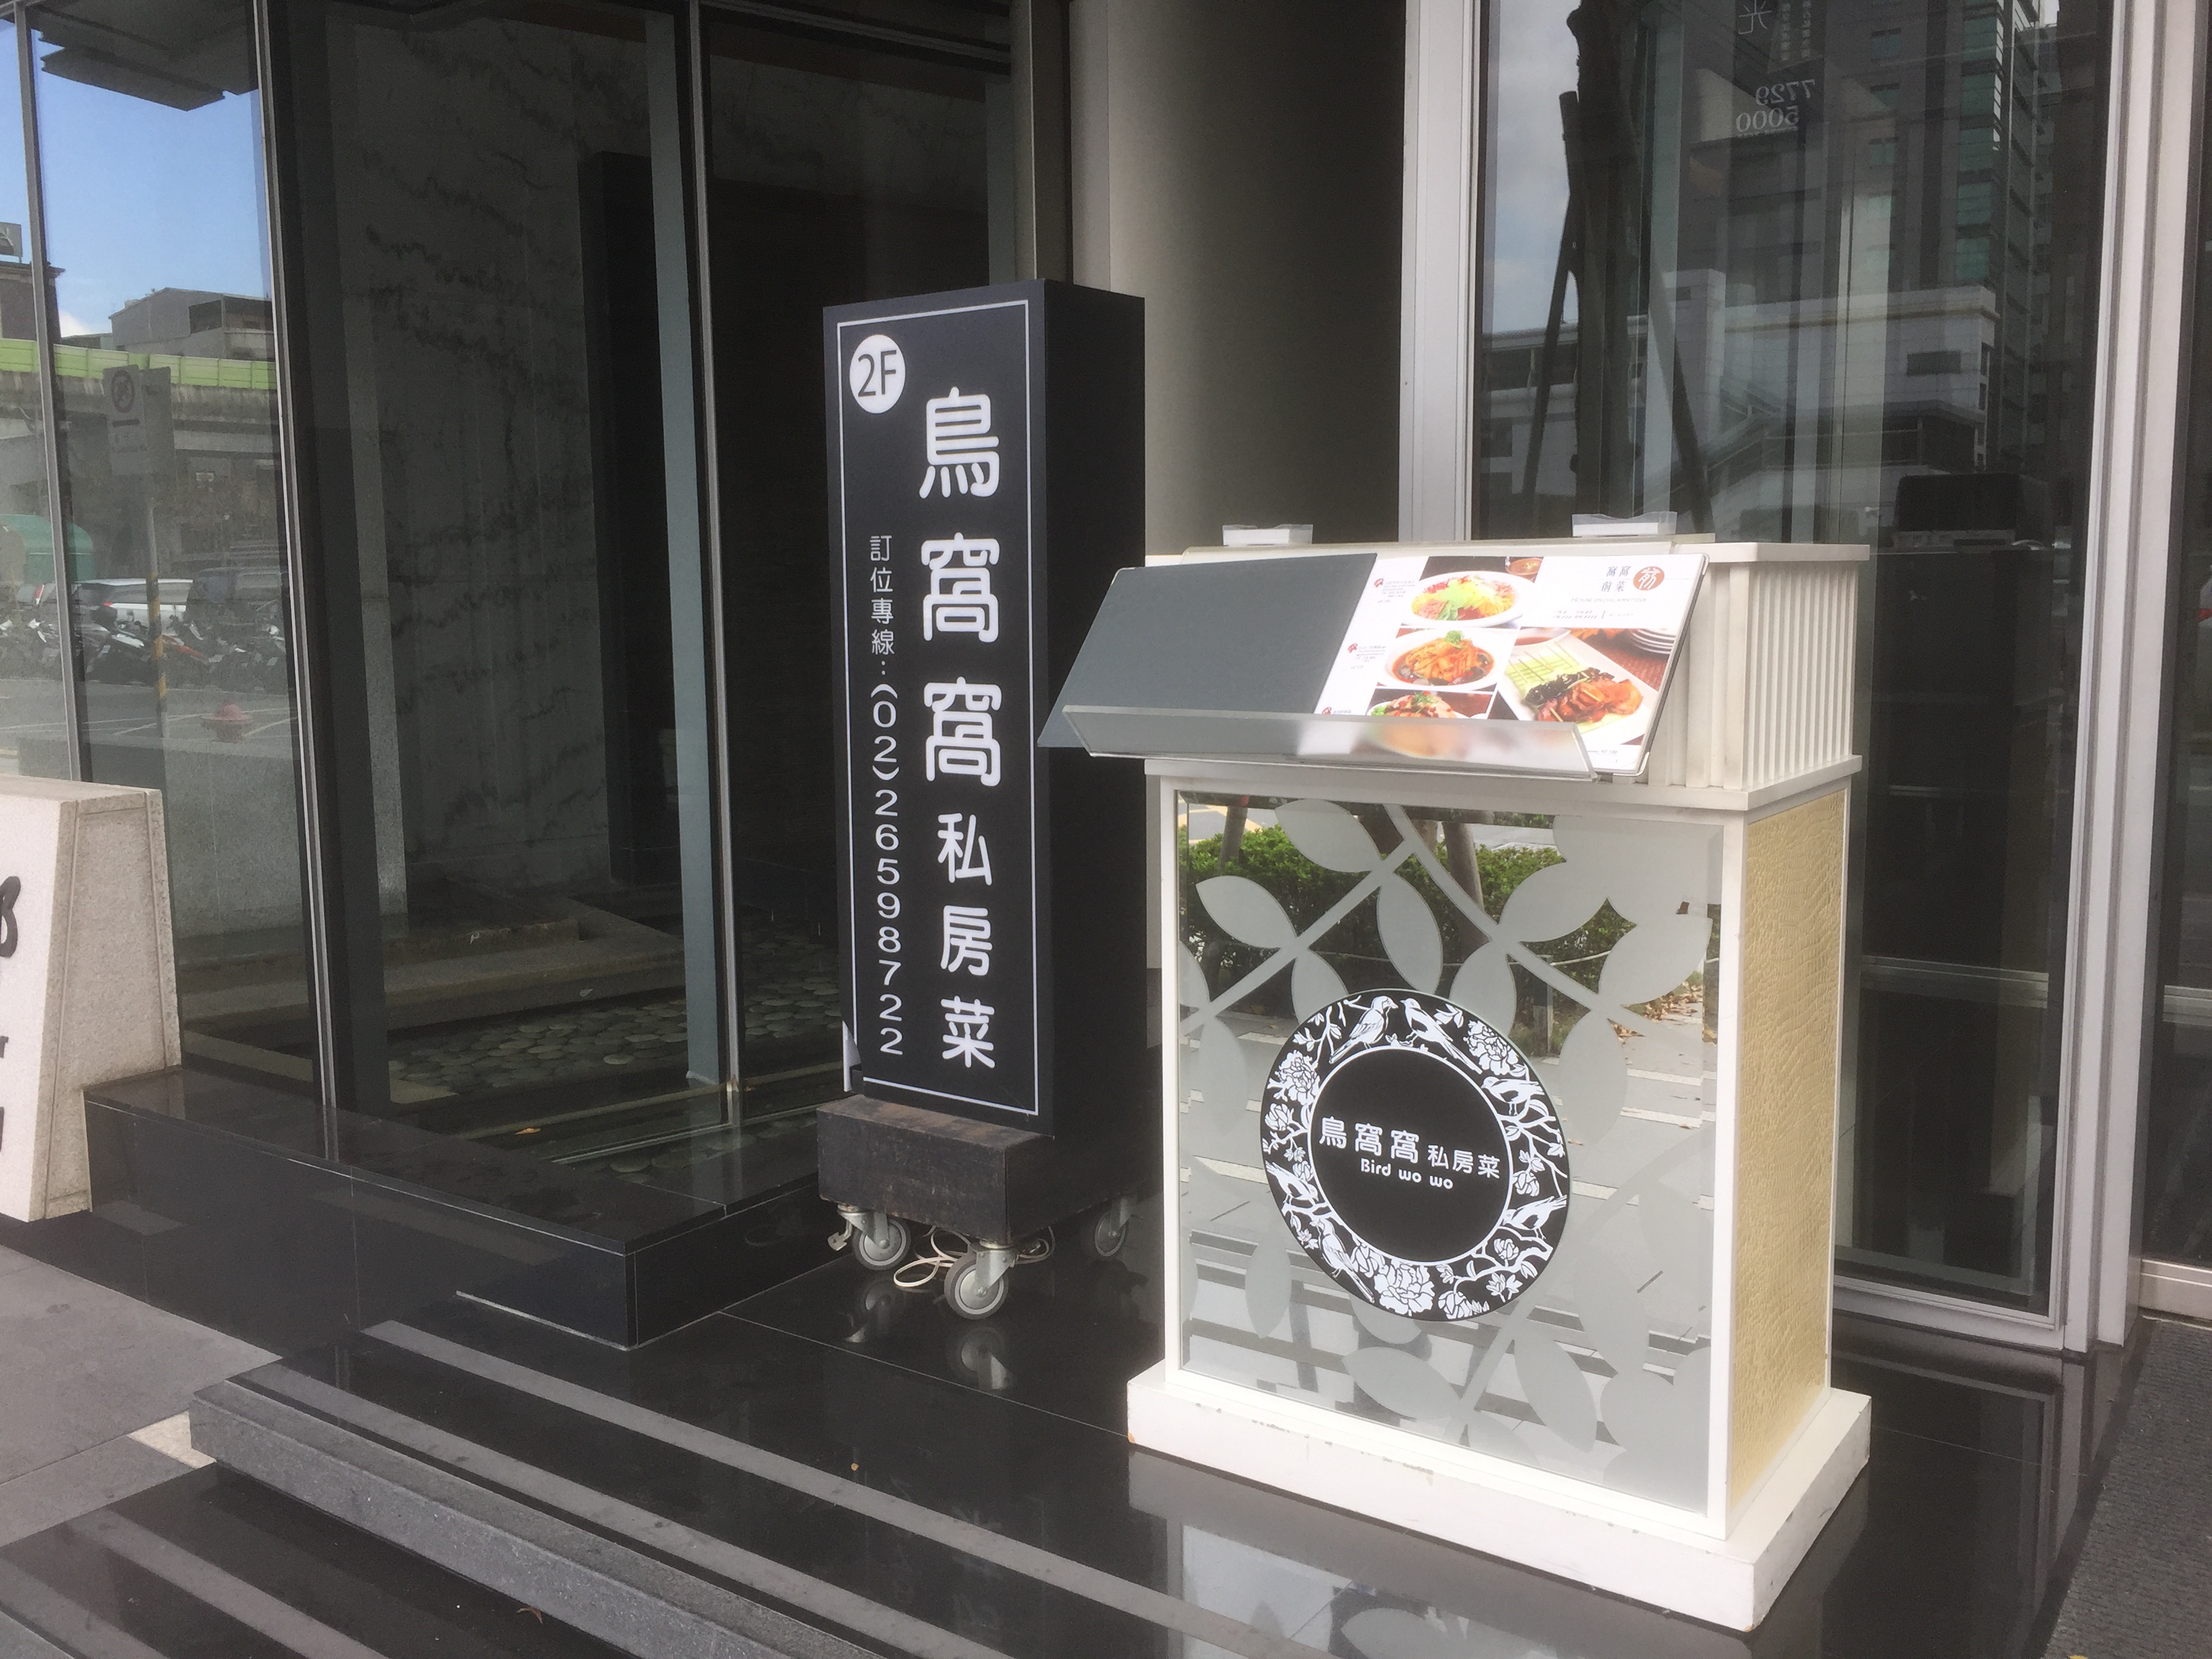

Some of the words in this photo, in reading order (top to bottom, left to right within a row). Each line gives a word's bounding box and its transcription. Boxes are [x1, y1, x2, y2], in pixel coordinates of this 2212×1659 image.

[857, 350, 898, 398] 2F
[919, 386, 1002, 1068] 鳥窩窩私房菜
[1319, 1115, 1500, 1179] 鳥窩窩私房菜
[1360, 1158, 1391, 1176] Bird
[1398, 1169, 1422, 1183] wo
[1429, 1174, 1453, 1189] wo
